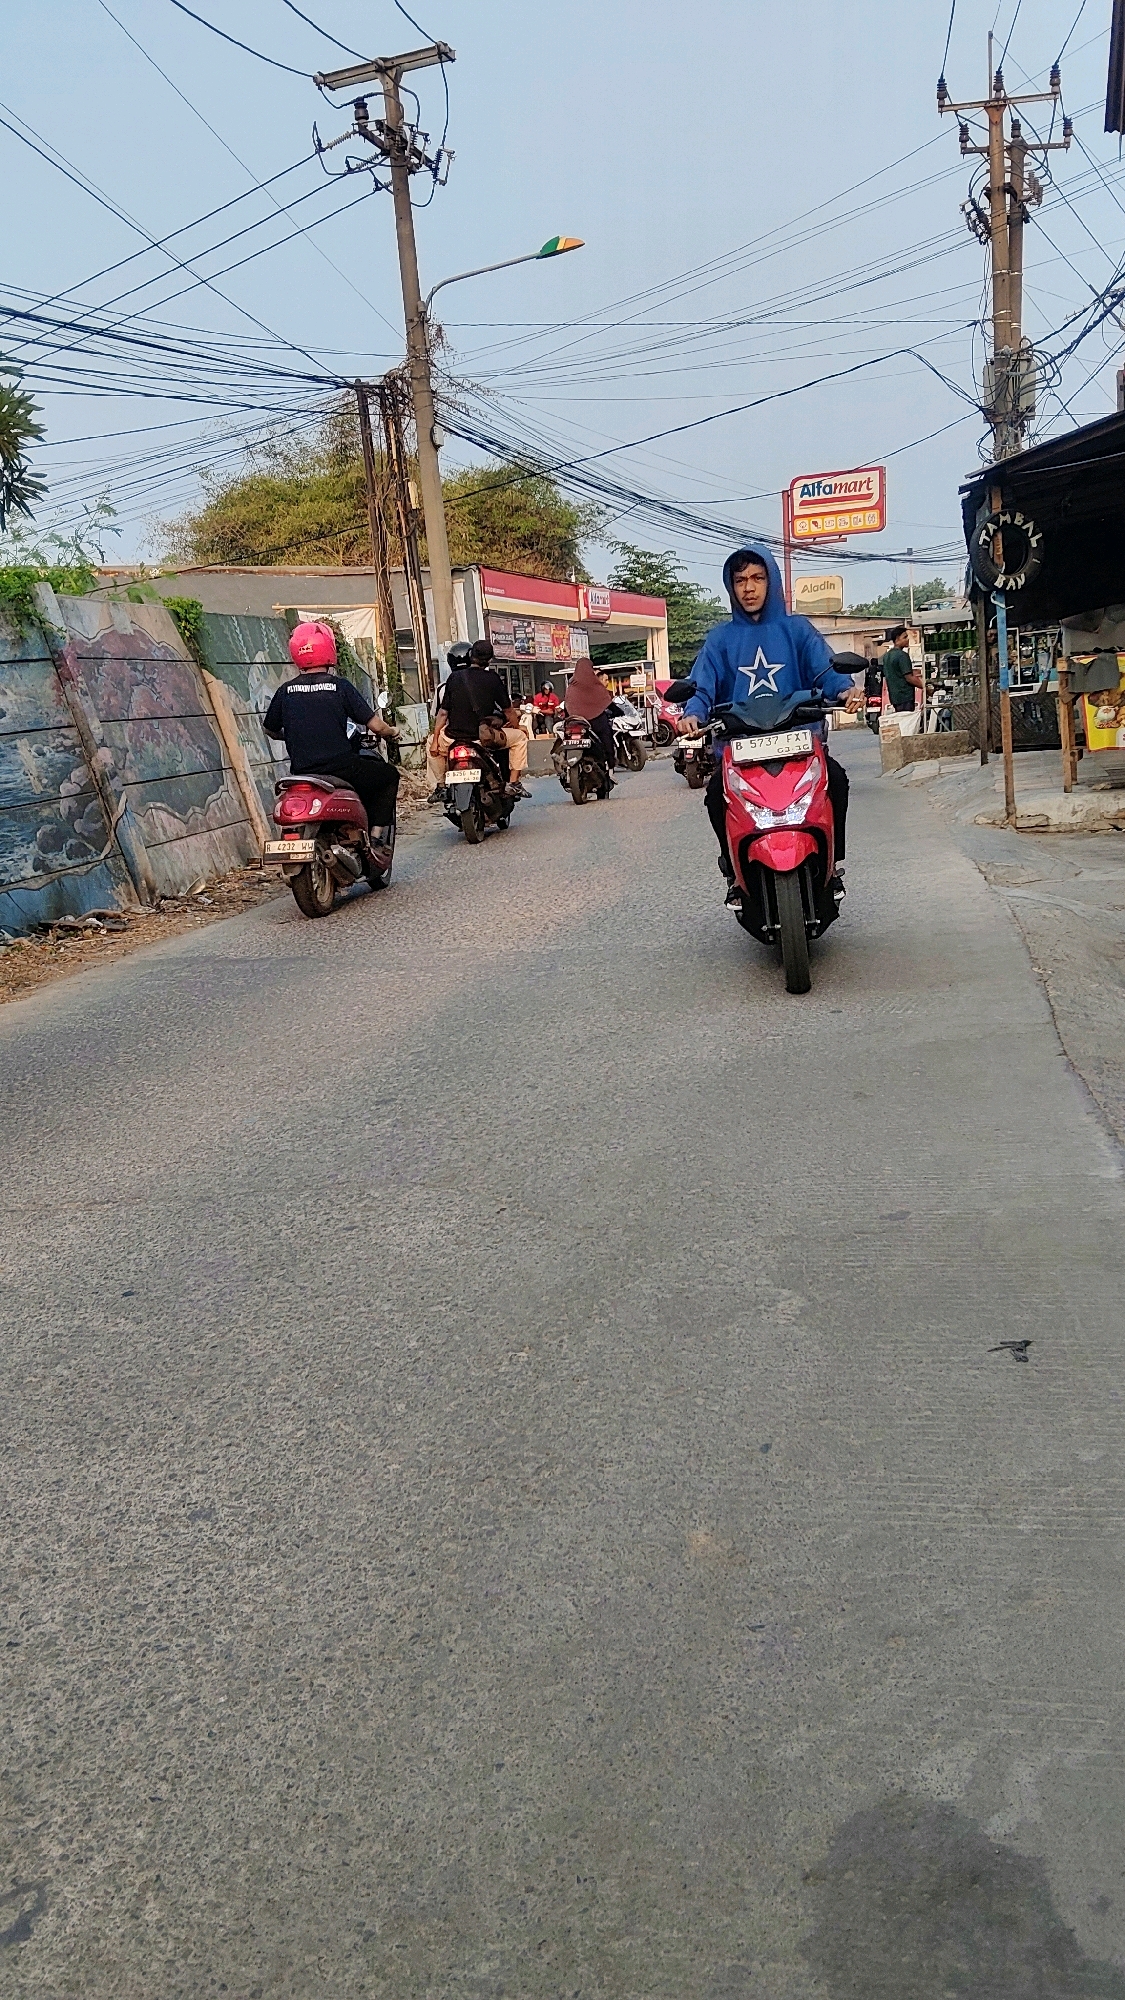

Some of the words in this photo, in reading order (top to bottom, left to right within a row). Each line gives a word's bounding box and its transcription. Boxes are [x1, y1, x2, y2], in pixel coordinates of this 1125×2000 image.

[800, 477, 874, 498] Alfamart
[979, 512, 1043, 548] TAMBAL
[801, 580, 836, 594] Aladin
[994, 573, 1026, 591] BAN
[735, 741, 743, 751] B
[749, 735, 779, 749] 5737
[786, 731, 808, 743] FXT
[277, 842, 296, 852] 4232
[301, 842, 314, 851] WW
